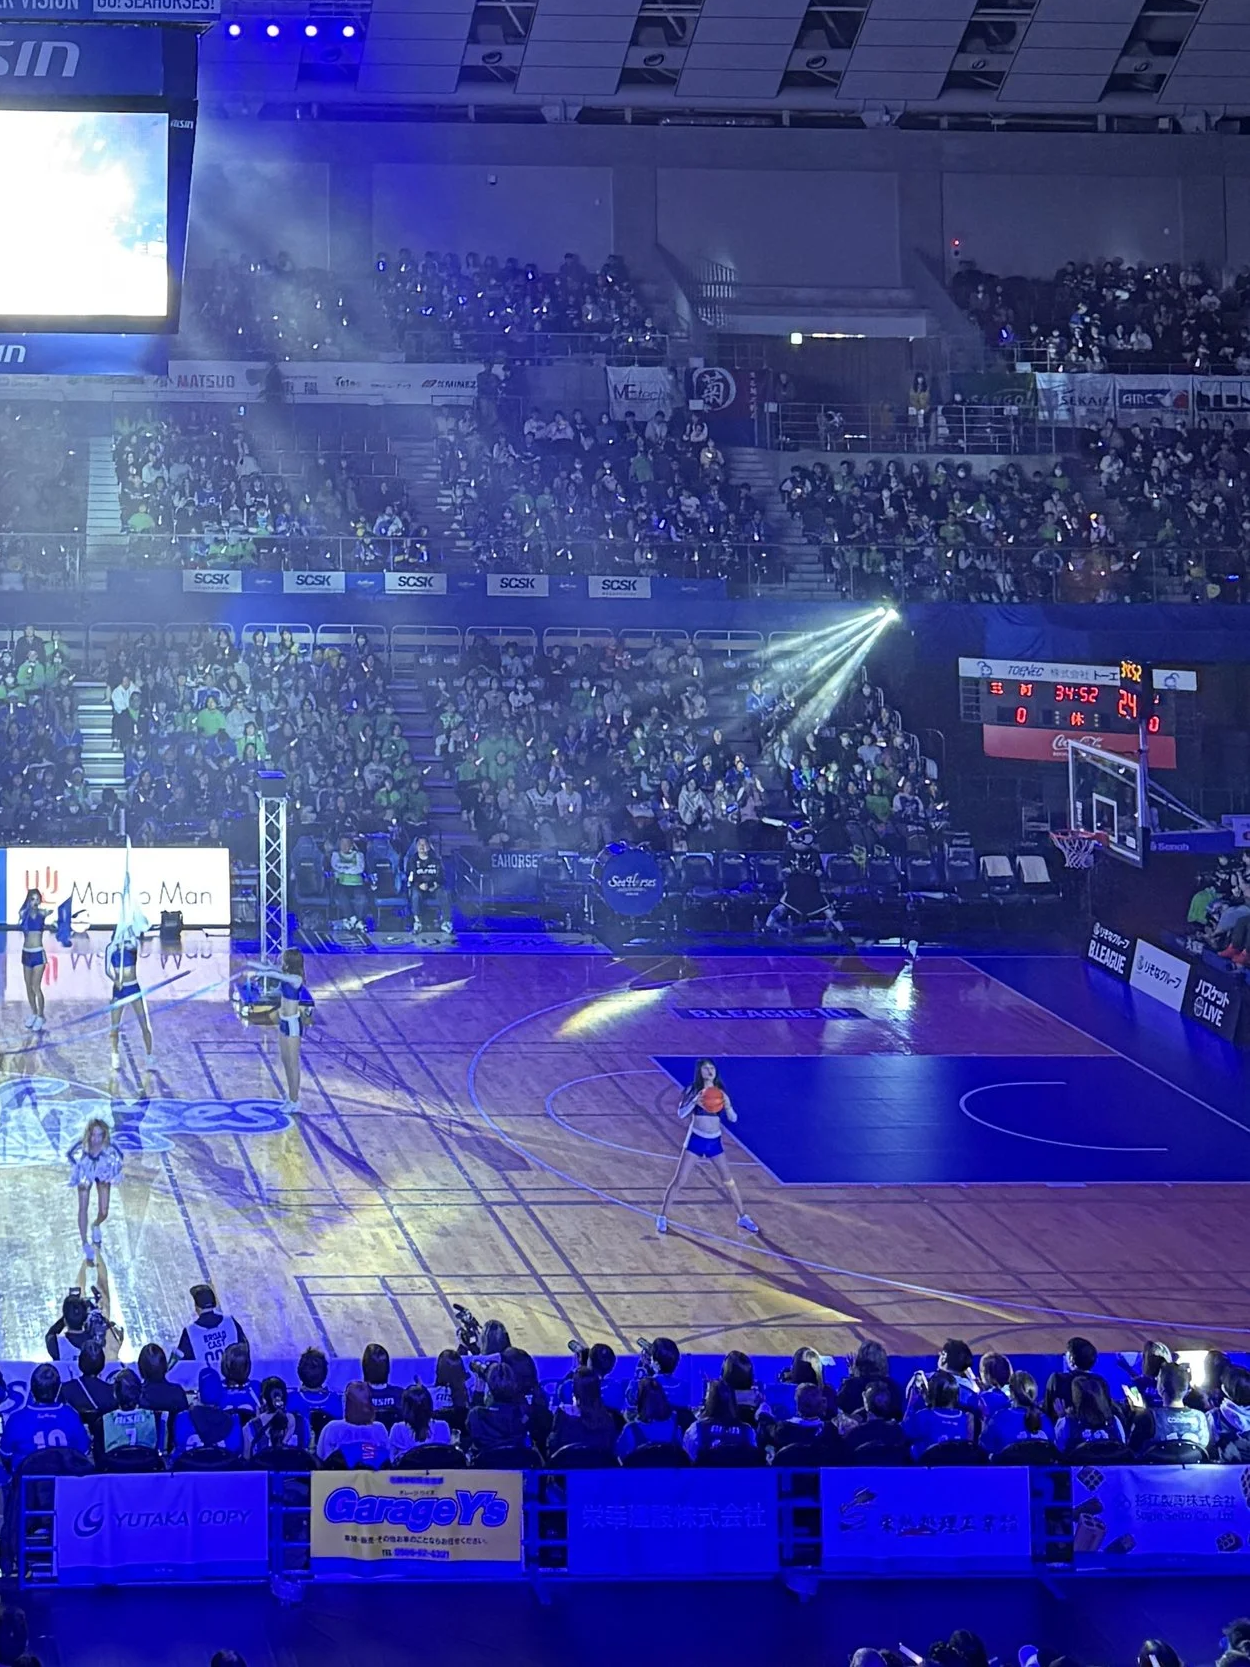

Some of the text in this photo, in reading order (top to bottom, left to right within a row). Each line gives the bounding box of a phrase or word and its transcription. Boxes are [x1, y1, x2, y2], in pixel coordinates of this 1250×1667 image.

[177, 374, 235, 388] MATSUO
[194, 573, 230, 584] SCSK
[295, 574, 331, 585] SCSK
[398, 576, 435, 587] SCSK
[500, 577, 535, 589] SCSK
[601, 579, 638, 591] SCSK
[1055, 685, 1099, 702] 34:52
[1118, 689, 1137, 717] 24
[1016, 707, 1027, 724] 0
[491, 853, 542, 868] EAHORSE
[71, 881, 122, 905] Man
[159, 881, 212, 905] Man
[1088, 939, 1127, 974] B.LEAGUE
[1144, 962, 1182, 989] りそなグループ
[1202, 1001, 1224, 1027] LIVE
[112, 1508, 253, 1528] YUTAKA COPY
